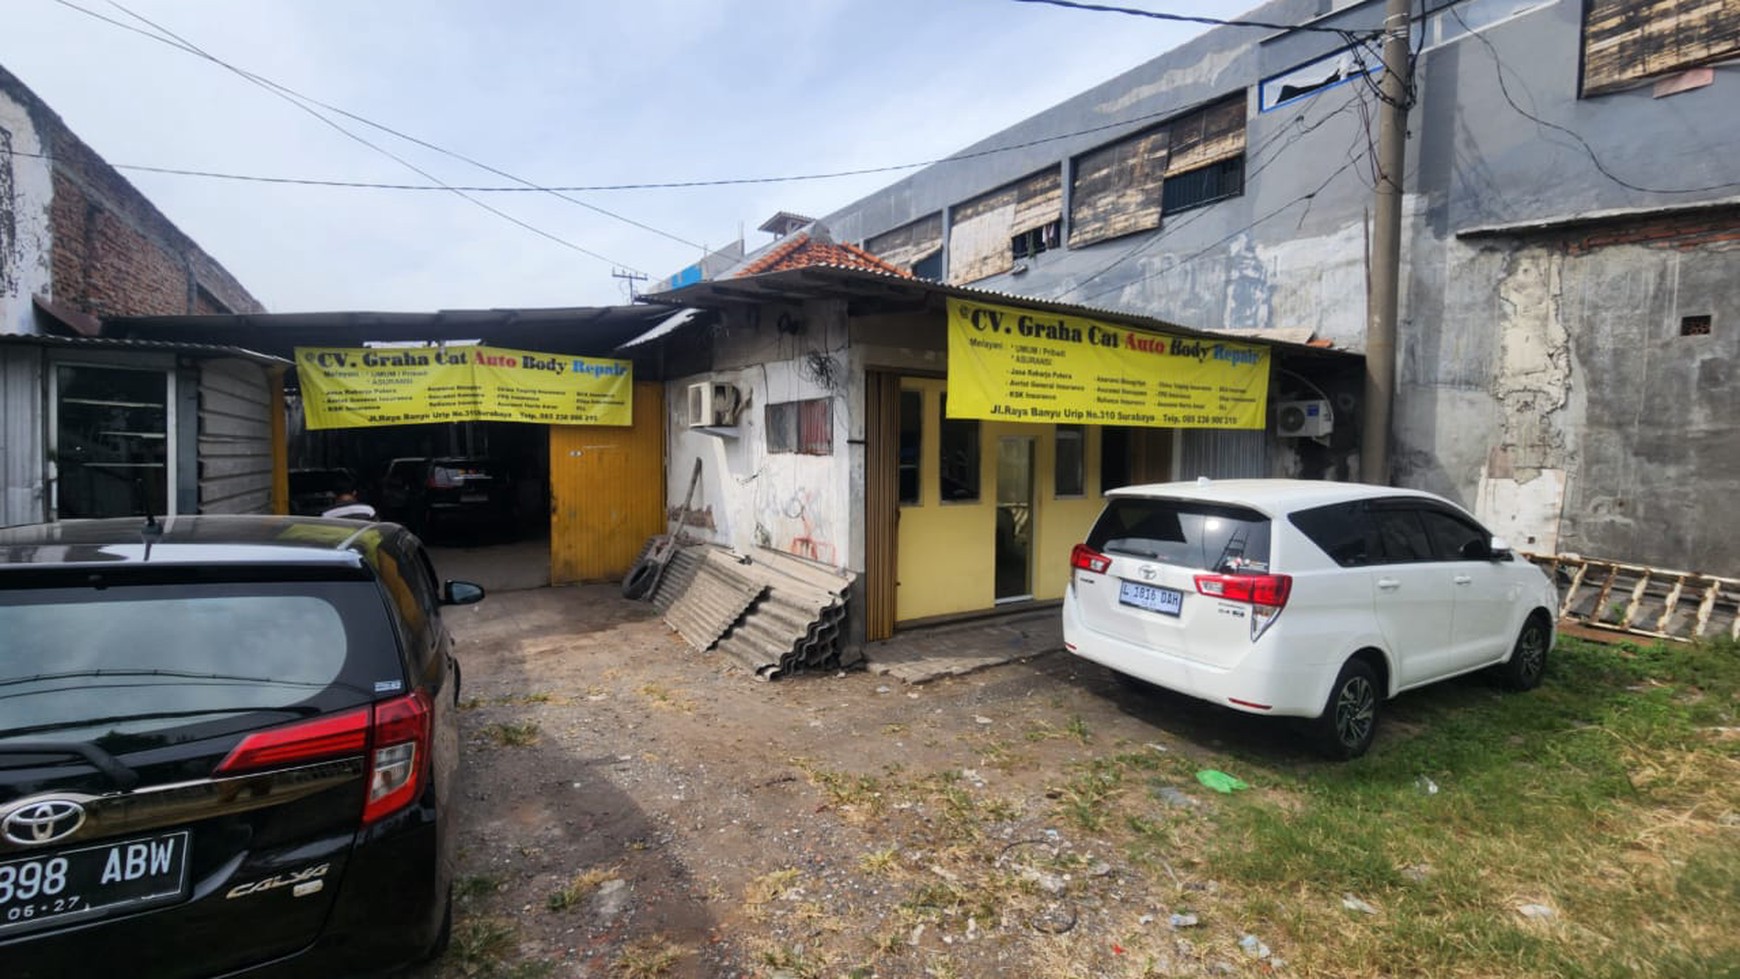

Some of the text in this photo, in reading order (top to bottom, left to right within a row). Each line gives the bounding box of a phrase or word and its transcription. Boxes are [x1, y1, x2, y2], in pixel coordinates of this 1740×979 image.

[971, 308, 1259, 367] CV. Graha Cat Auto Body Repair
[317, 350, 628, 378] CV. Graha Cat Auto Body Repair
[403, 412, 430, 421] Banyu
[433, 411, 450, 419] Urip
[1031, 407, 1061, 419] Banyu
[1064, 409, 1084, 420] Urip
[1117, 411, 1155, 423] Surabaya
[101, 839, 174, 885] ABW
